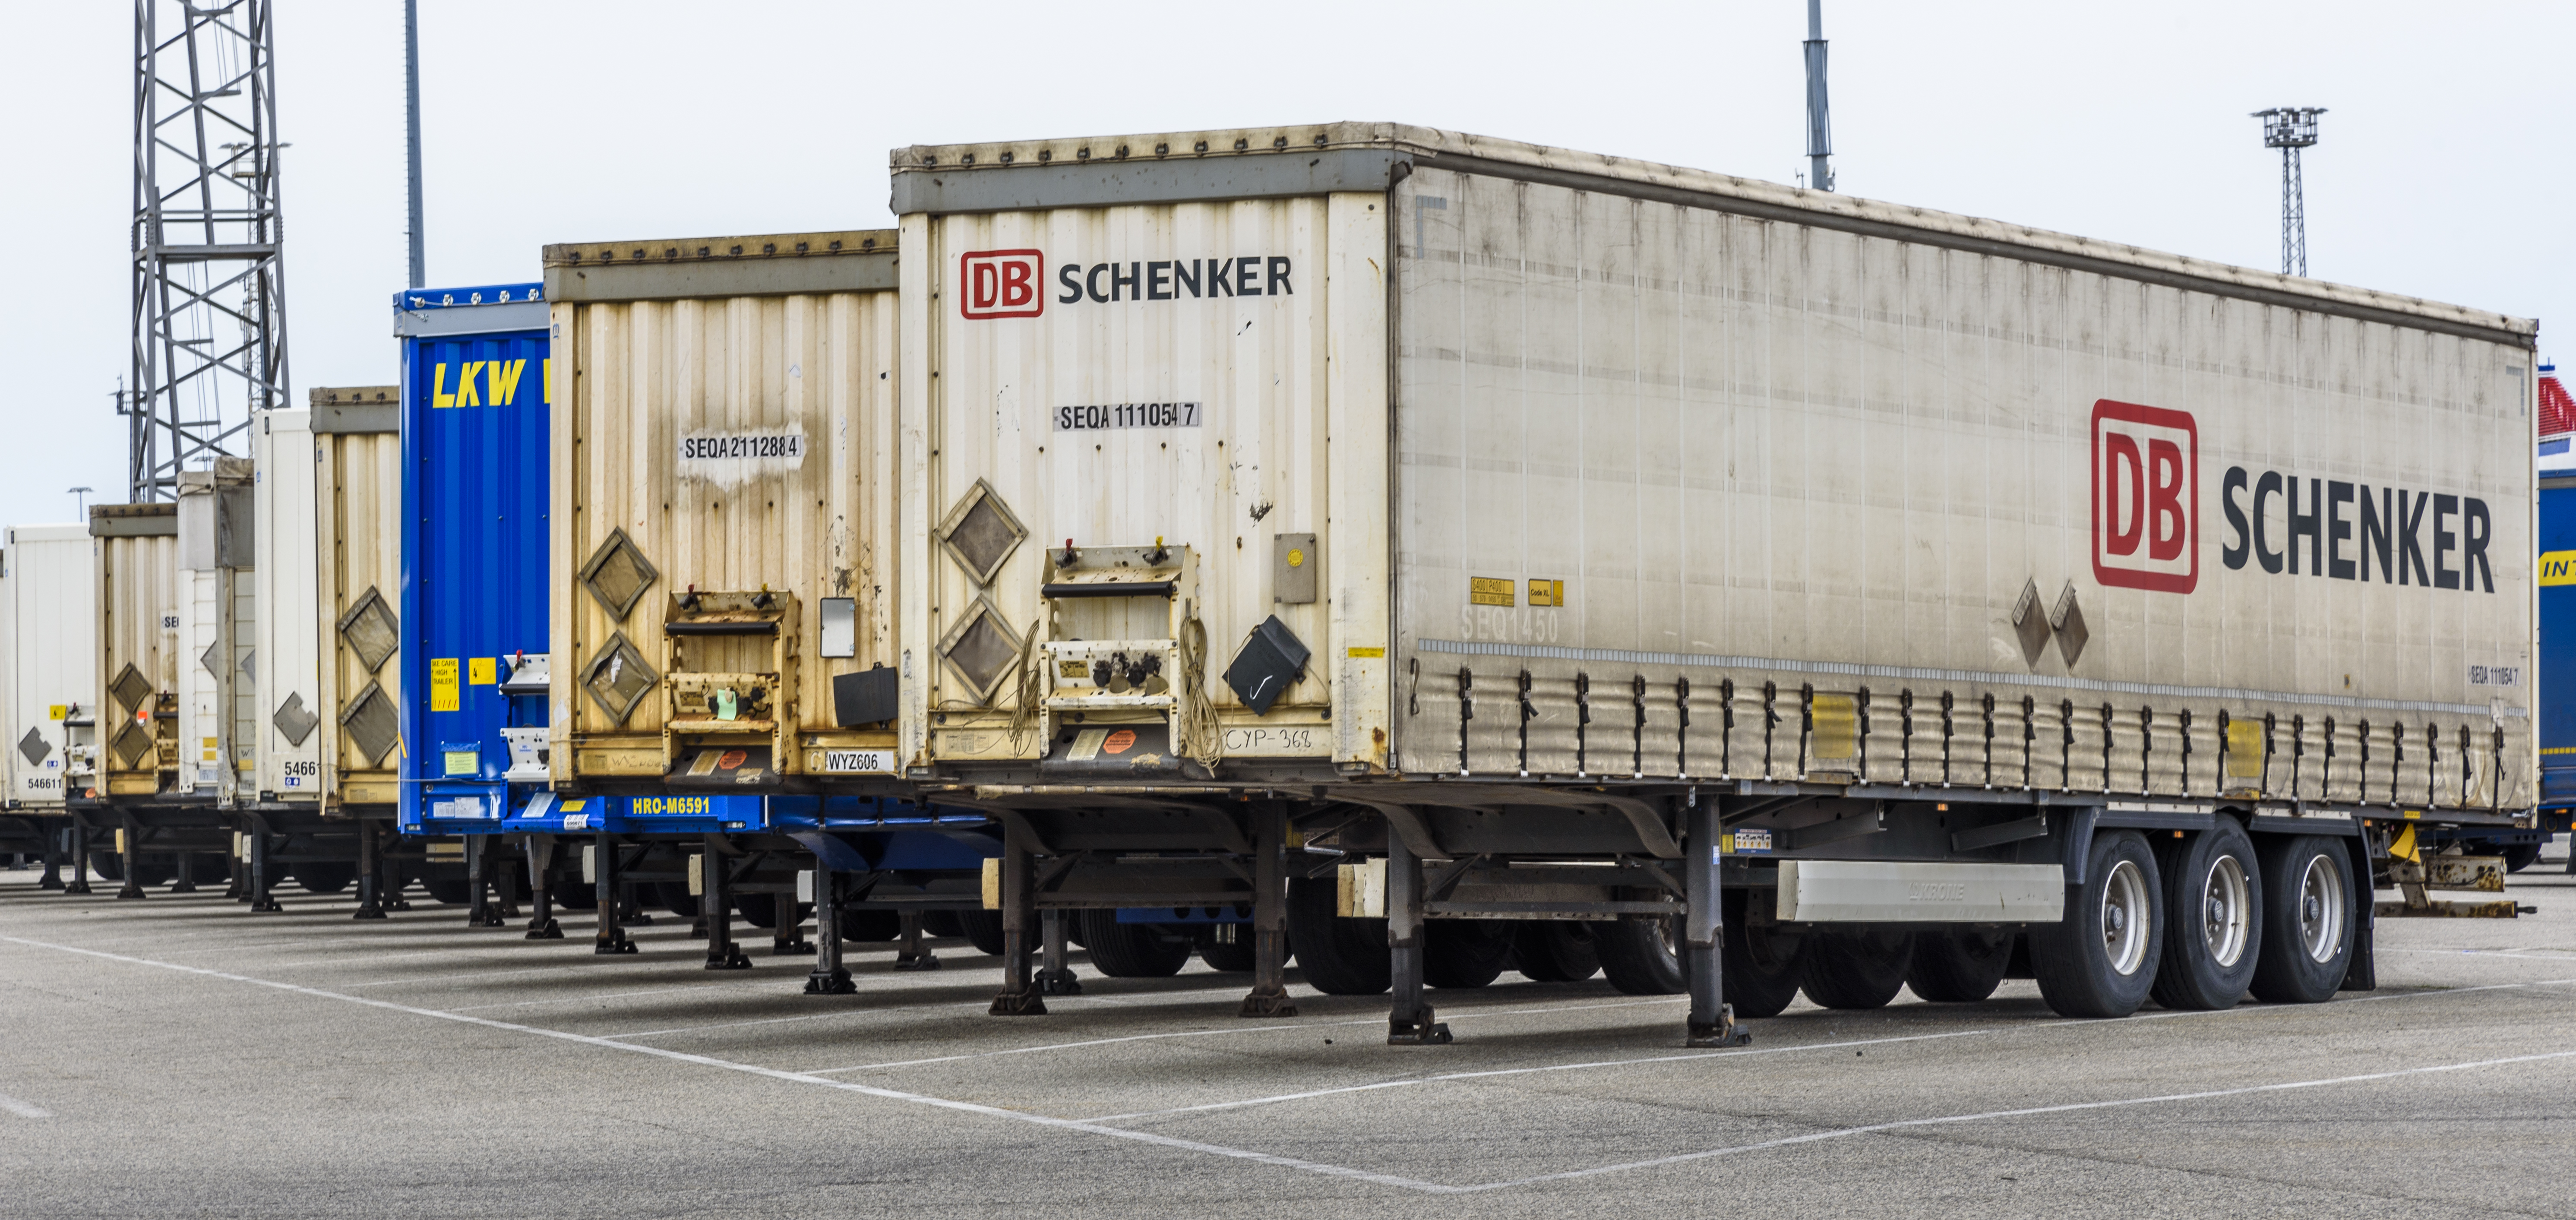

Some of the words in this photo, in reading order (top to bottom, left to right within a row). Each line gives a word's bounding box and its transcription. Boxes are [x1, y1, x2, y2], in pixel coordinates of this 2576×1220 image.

[974, 261, 1033, 308] DB
[1059, 256, 1293, 304] SCHENKER
[433, 359, 526, 408] LKW
[1061, 405, 1109, 429] SEQA
[1115, 403, 1178, 427] 111054
[1184, 404, 1195, 426] 7
[686, 438, 728, 458] SEQA
[731, 436, 785, 457] 211288
[788, 436, 797, 456] 4
[2106, 431, 2186, 561] DB
[2222, 466, 2495, 594] SCHENKER
[1472, 578, 1486, 591] S400
[1489, 580, 1502, 592] P400
[165, 616, 179, 628] SE
[1461, 604, 1558, 643] SEQ1450
[2471, 665, 2488, 684] SEQA
[1226, 729, 1311, 750] CYP-368
[828, 753, 878, 770] WYZ606
[28, 778, 61, 789] 546611
[633, 797, 709, 814] HRO-M6591
